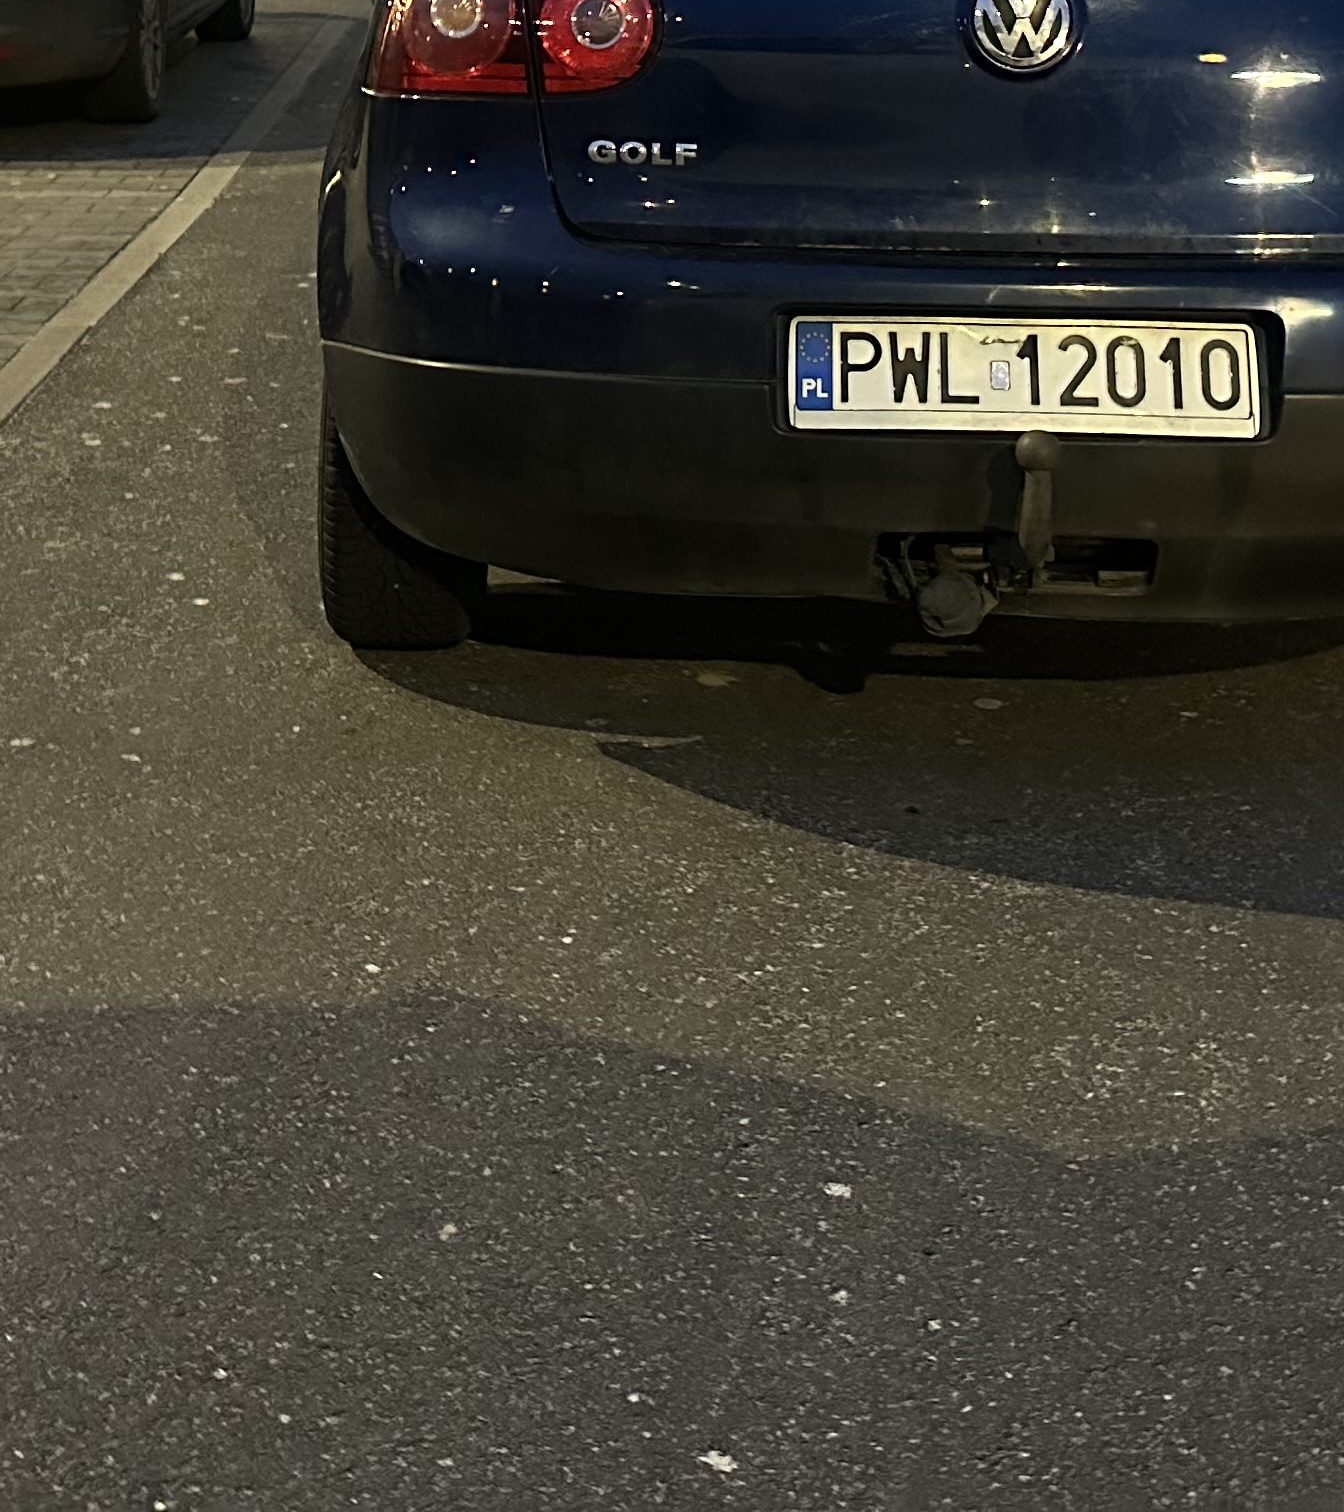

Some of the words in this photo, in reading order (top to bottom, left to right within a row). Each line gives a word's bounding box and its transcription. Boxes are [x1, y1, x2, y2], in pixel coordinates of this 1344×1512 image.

[587, 139, 698, 166] GOLF
[840, 331, 980, 405] PWL
[1016, 333, 1241, 412] 12010
[801, 377, 829, 398] PL
